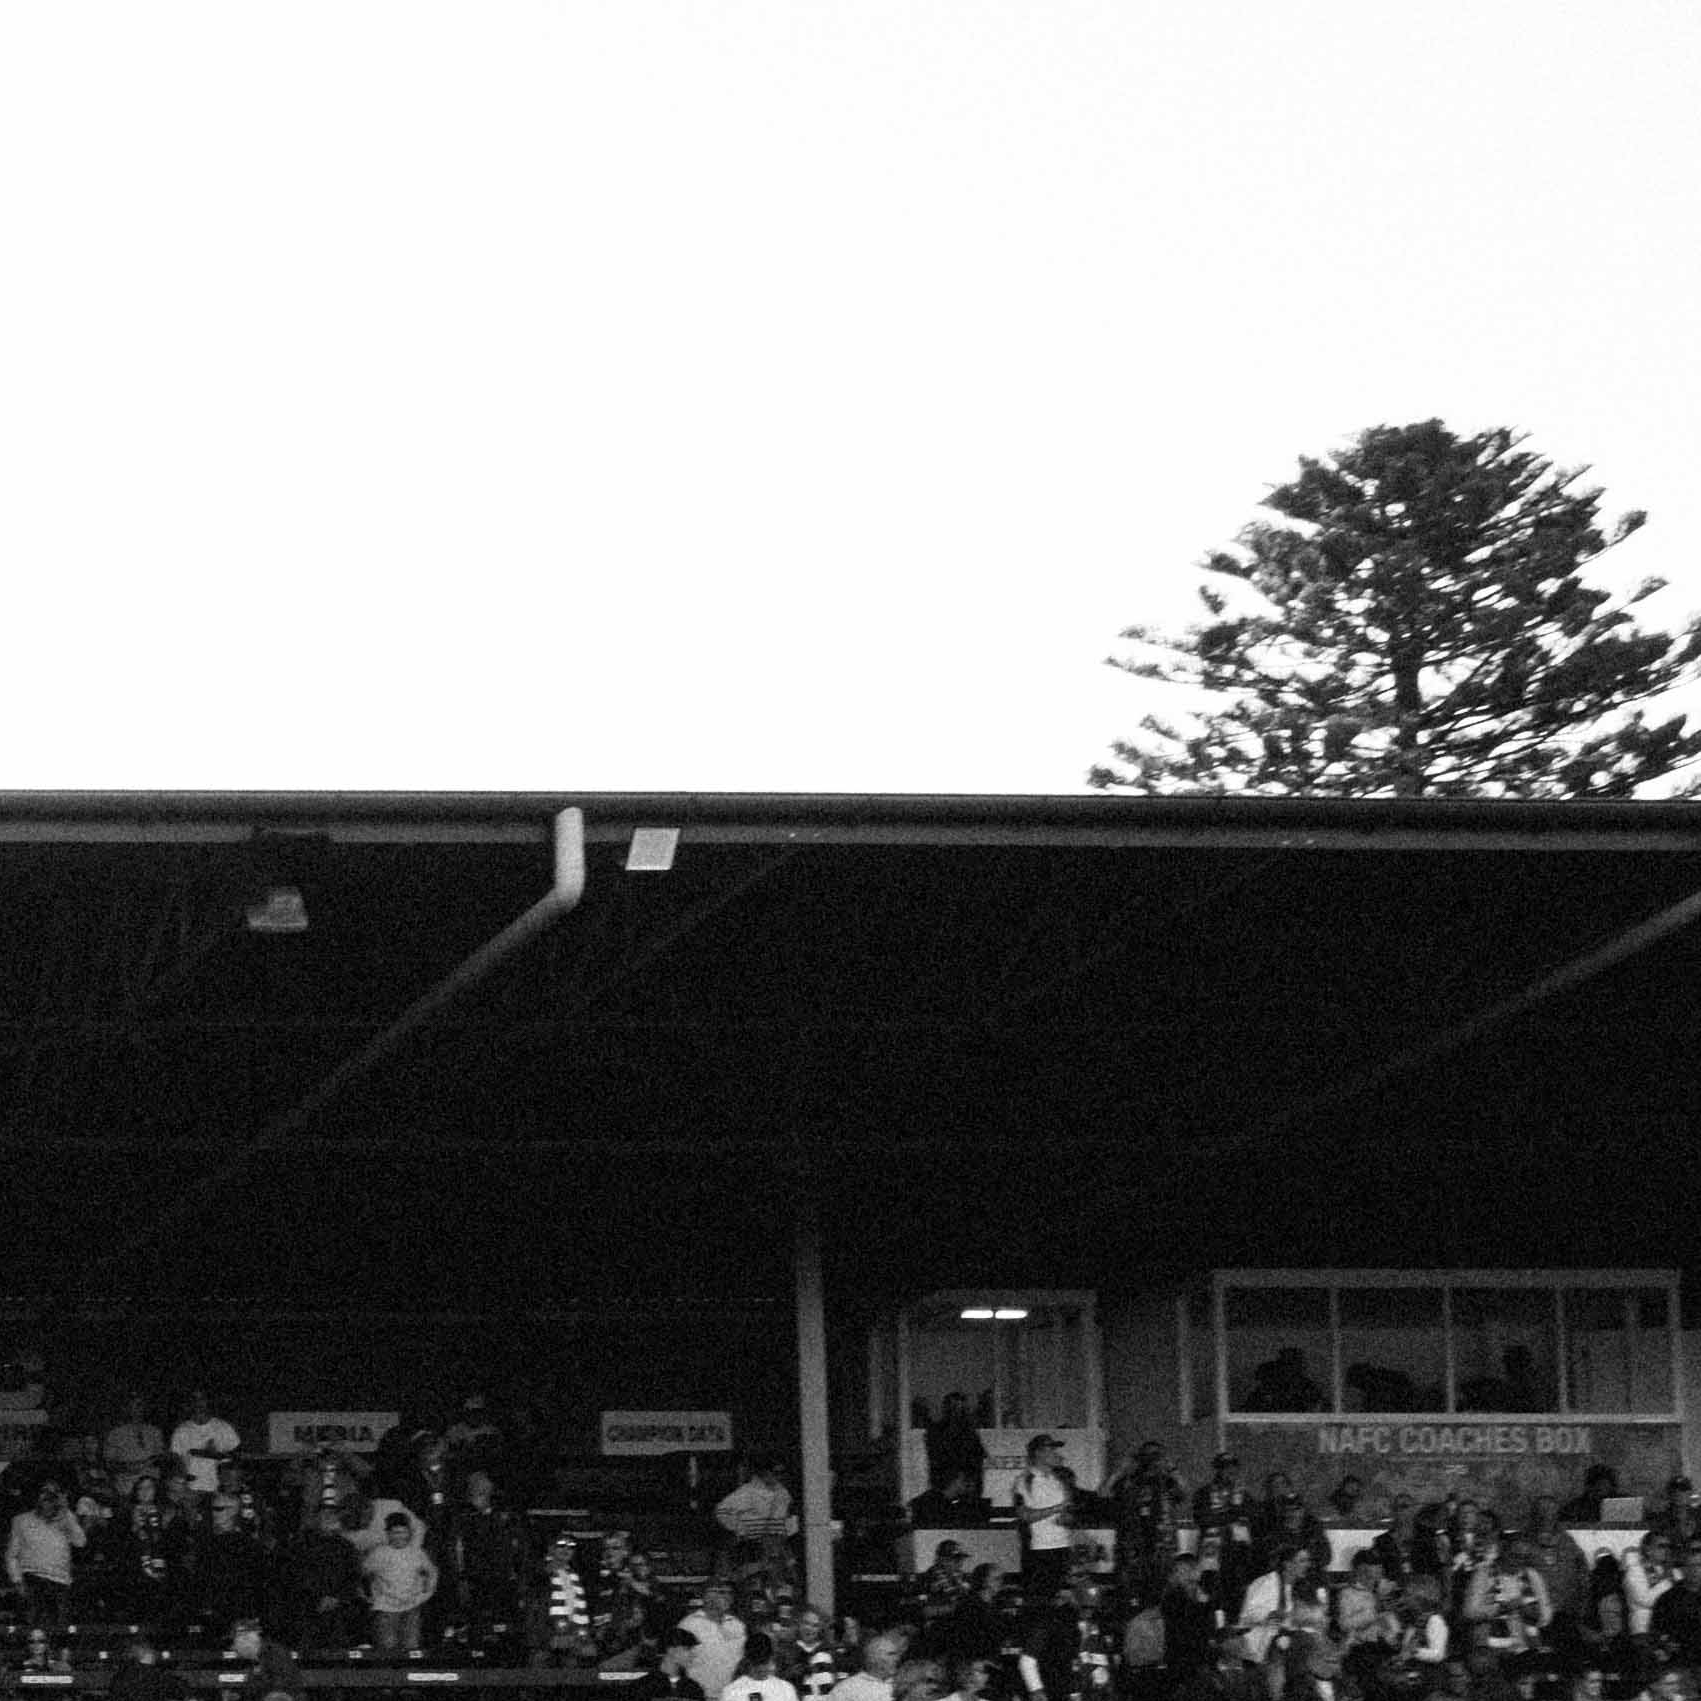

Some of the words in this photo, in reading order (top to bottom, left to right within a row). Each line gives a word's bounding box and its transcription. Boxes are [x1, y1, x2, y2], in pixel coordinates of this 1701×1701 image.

[1318, 1426, 1391, 1454] NAFC
[1399, 1426, 1528, 1454] COACHES
[1536, 1426, 1591, 1454] BOX
